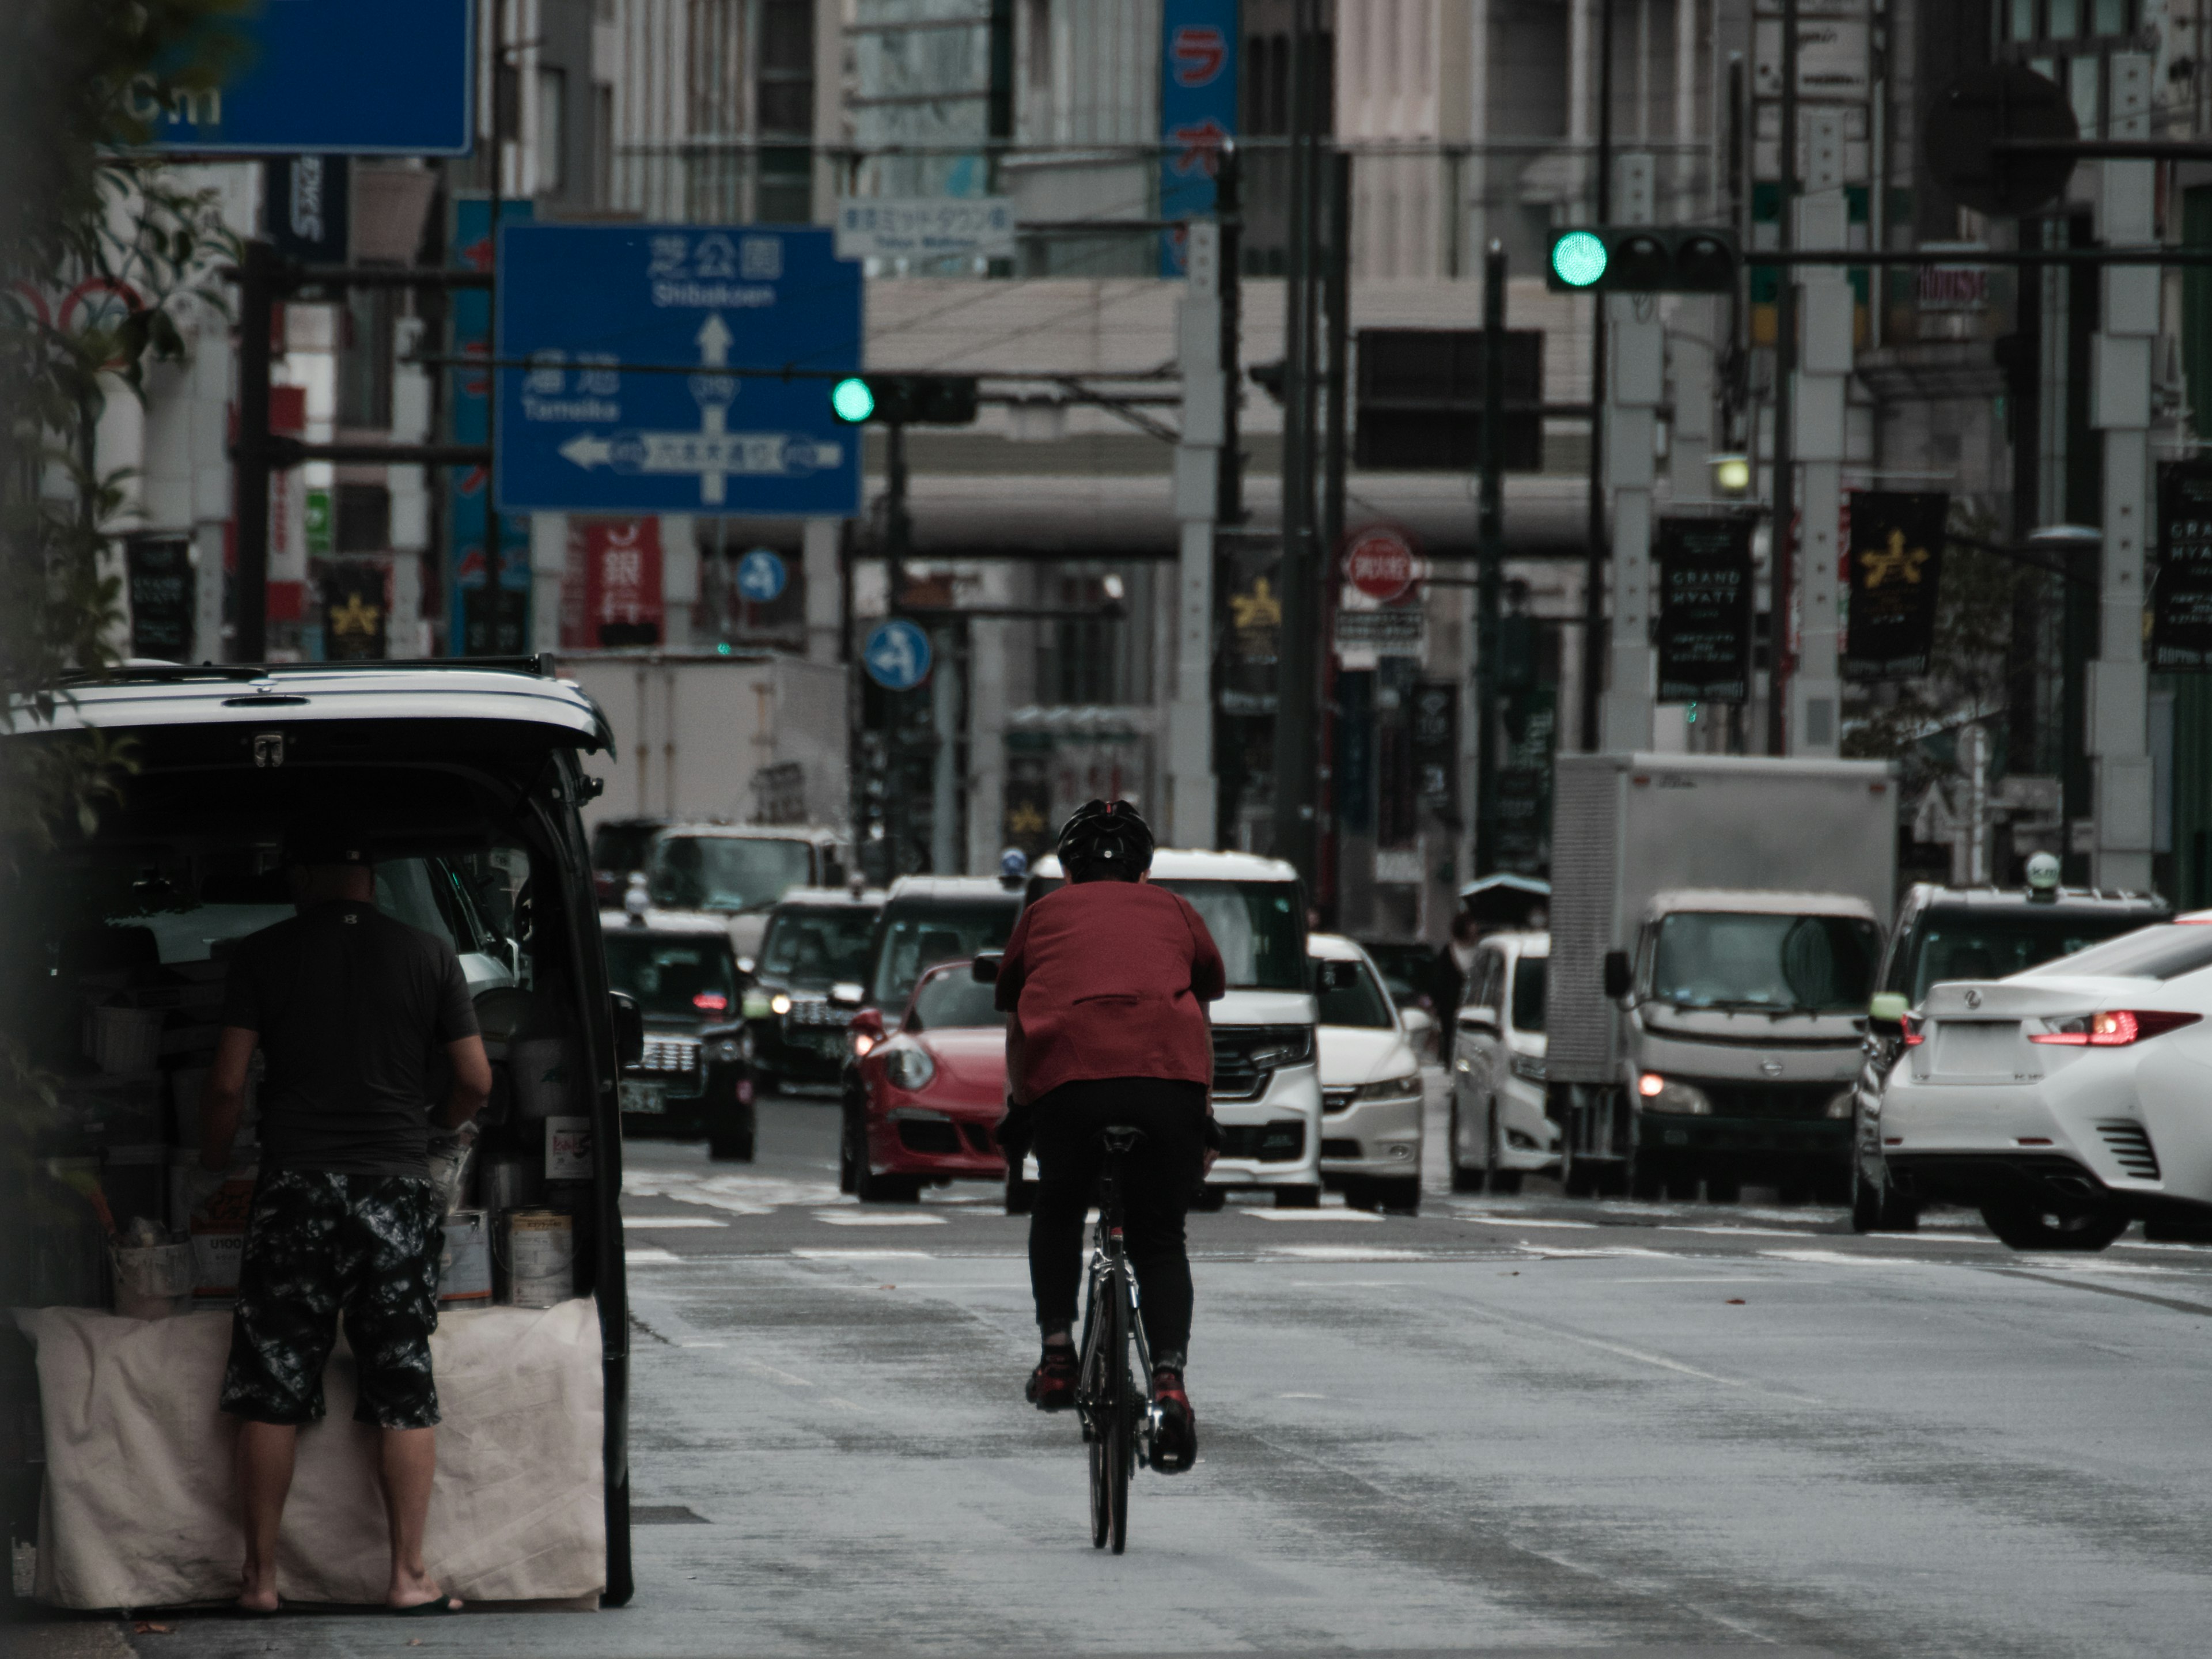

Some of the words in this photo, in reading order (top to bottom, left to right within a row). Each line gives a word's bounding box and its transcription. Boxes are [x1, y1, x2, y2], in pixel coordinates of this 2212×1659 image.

[647, 234, 783, 281] 芝公園
[653, 283, 776, 307] Shibakoen
[1671, 570, 1741, 586] GRAND
[1671, 589, 1738, 605] HYATT
[210, 1238, 241, 1249] U100
